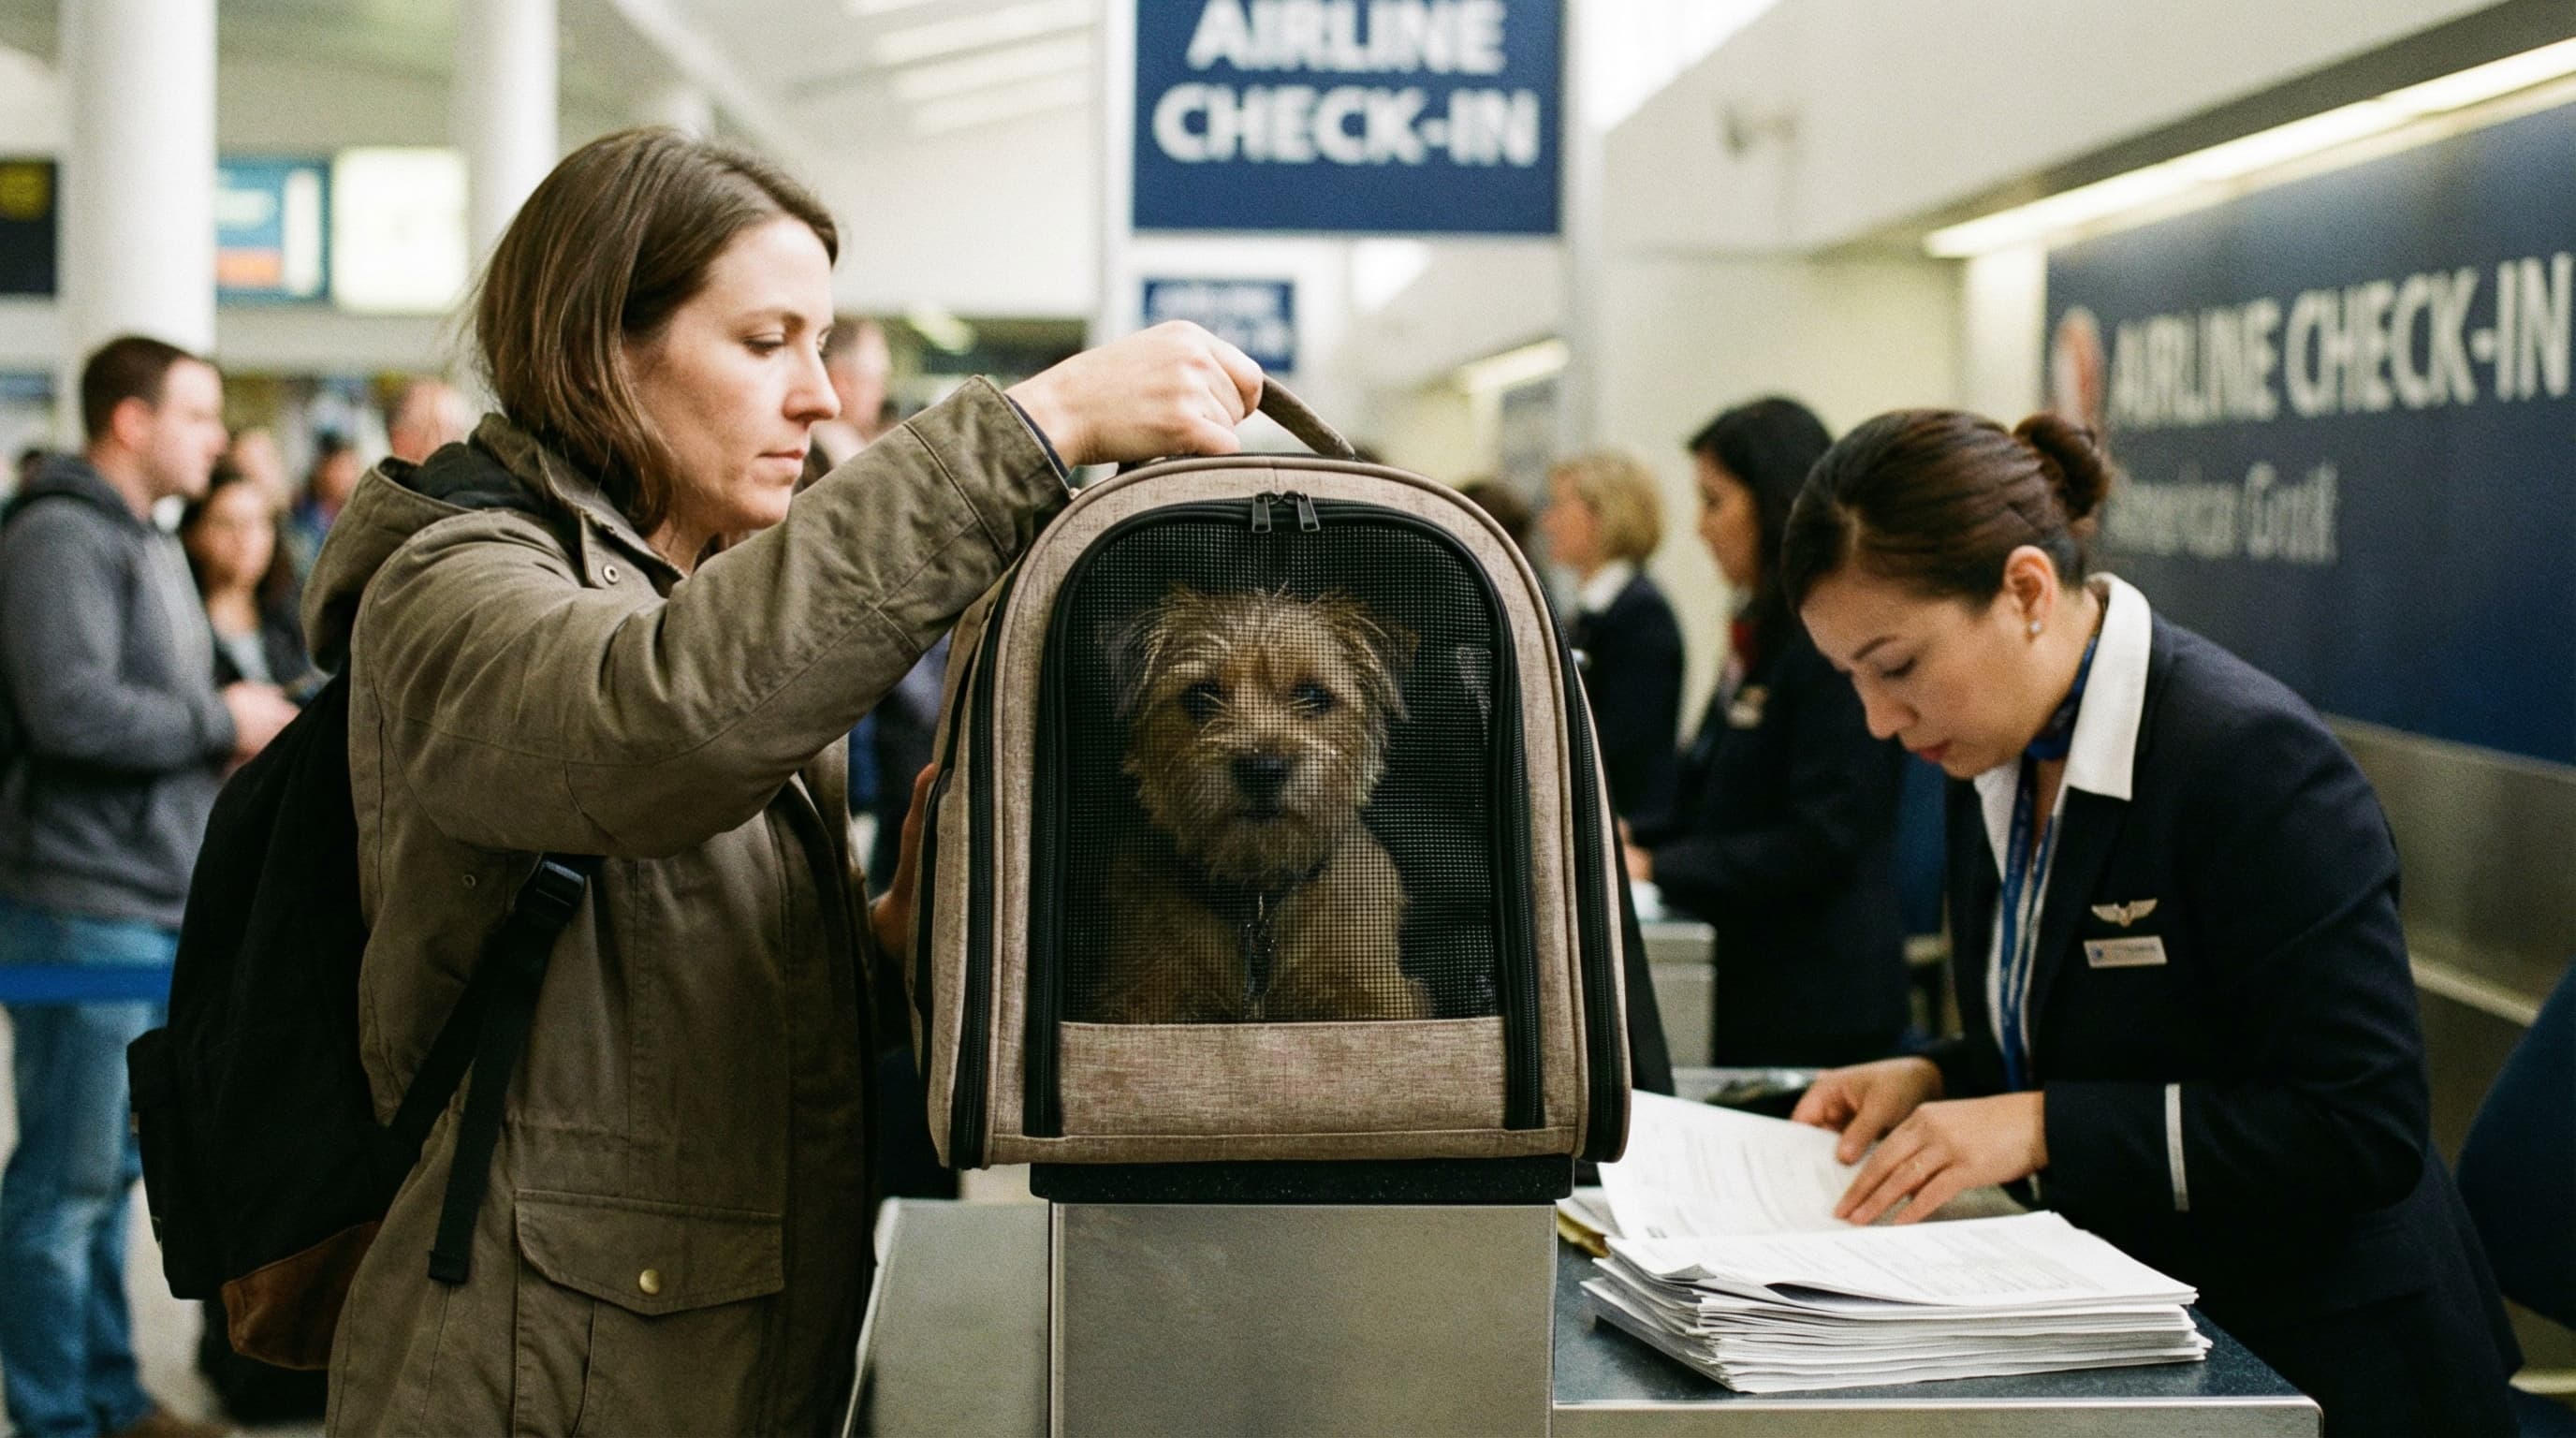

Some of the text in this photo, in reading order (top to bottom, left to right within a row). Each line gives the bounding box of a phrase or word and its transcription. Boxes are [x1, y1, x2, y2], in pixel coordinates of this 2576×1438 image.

[1186, 0, 1506, 73] AIRLINE
[1153, 83, 1540, 166] CHECK-IN
[2110, 253, 2573, 429] AIRLINE CHECK-IN
